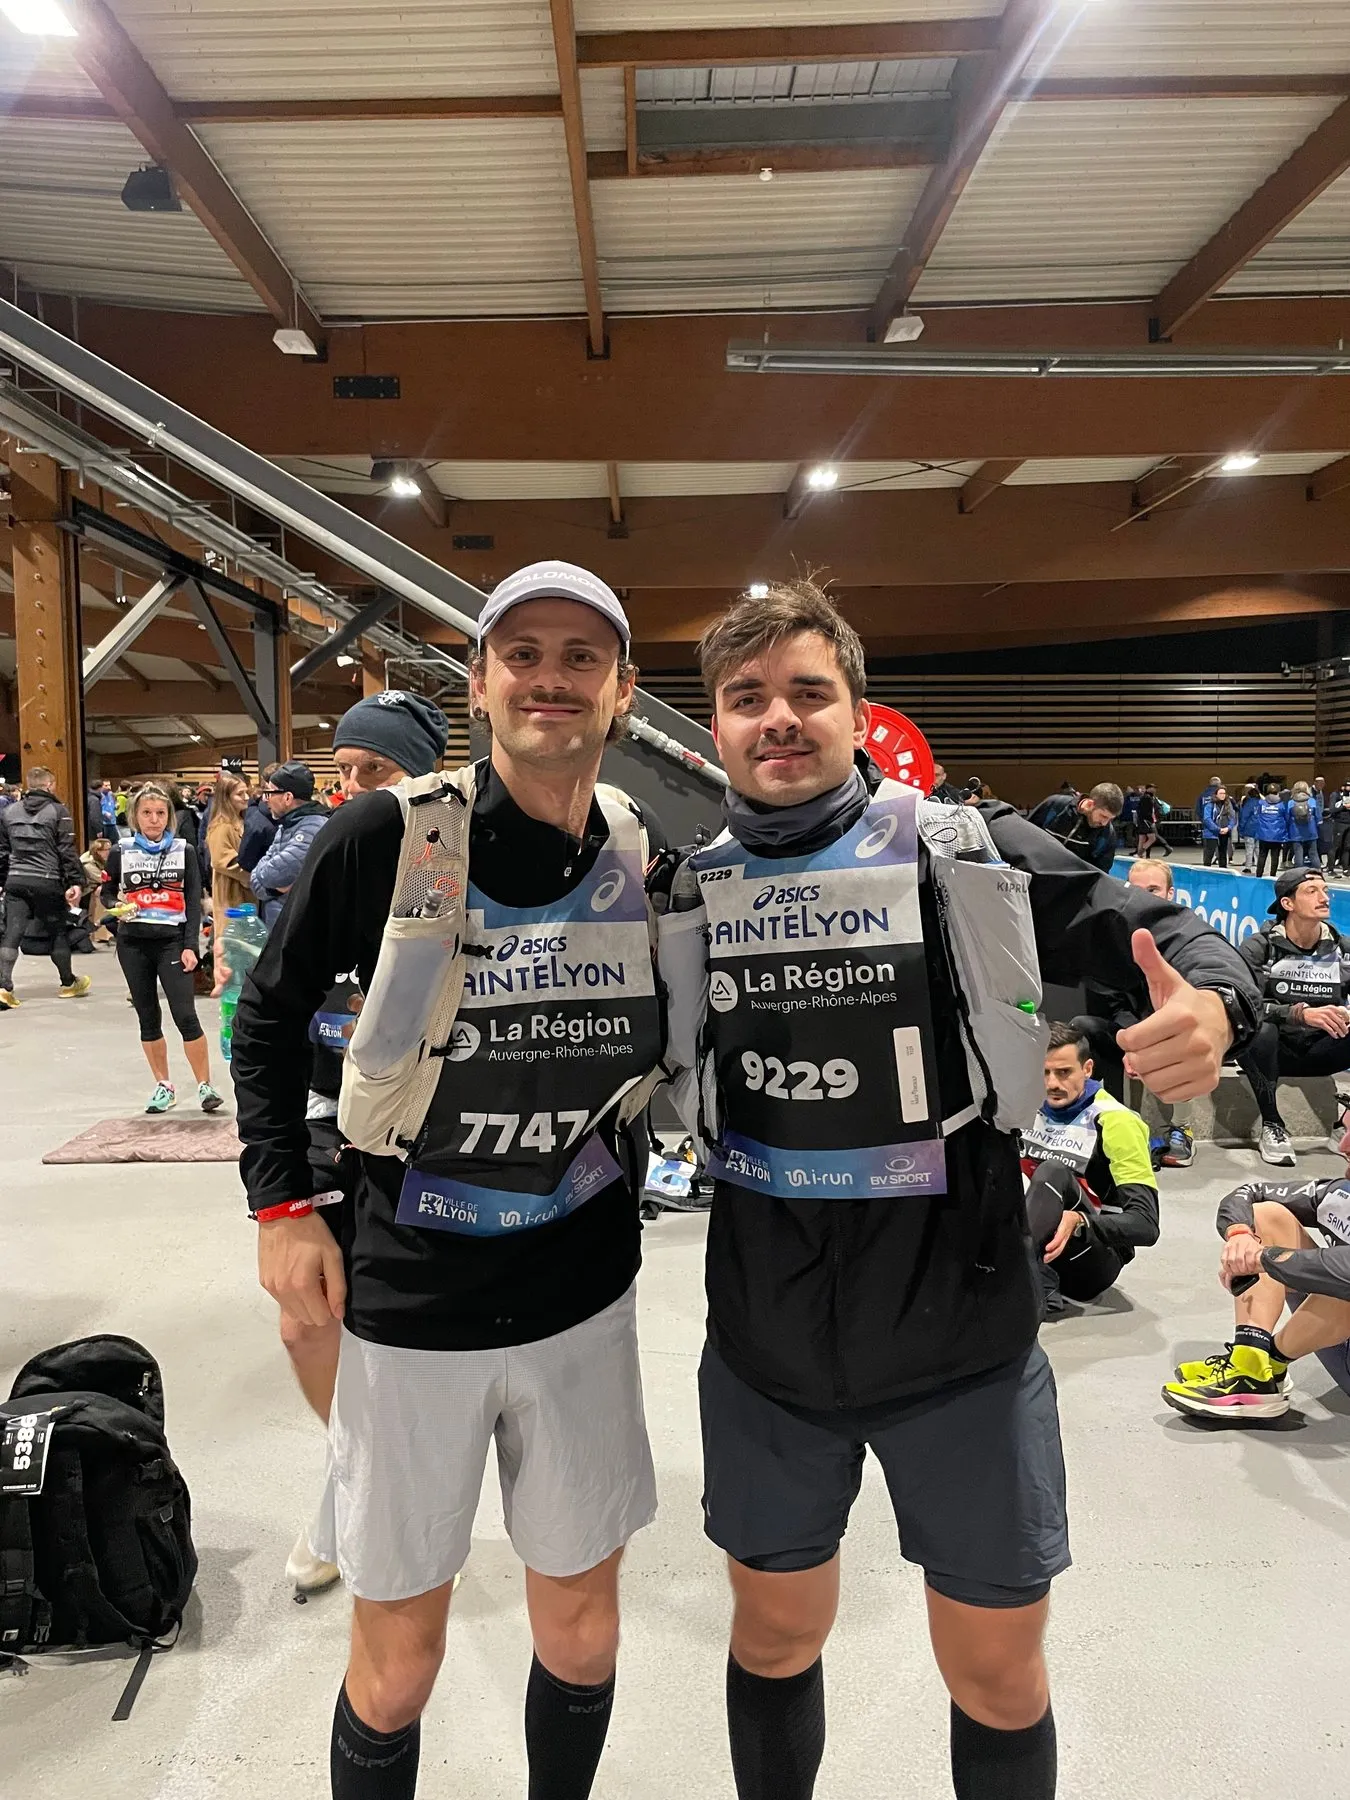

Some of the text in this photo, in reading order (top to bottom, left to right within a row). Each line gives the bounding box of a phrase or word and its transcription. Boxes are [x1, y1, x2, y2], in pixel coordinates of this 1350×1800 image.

[507, 571, 605, 594] SALOMON
[700, 869, 733, 884] 9229
[775, 884, 821, 905] asics
[520, 936, 568, 955] asics
[464, 956, 626, 996] AINTÉLYON
[743, 960, 896, 993] La Région
[1290, 983, 1333, 994] La Région
[751, 990, 898, 1014] Auvergne-Rhône-Alpes
[489, 1011, 631, 1044] La Région
[488, 1043, 633, 1063] Auvergne-Rhône-Alpes
[741, 1050, 859, 1100] 9229
[458, 1109, 590, 1154] 7747
[1028, 1147, 1039, 1158] La
[574, 1165, 604, 1194] SPORT
[745, 1162, 771, 1183] LYON
[811, 1169, 853, 1185] i-run
[870, 1172, 932, 1186] BV SPORT
[442, 1203, 478, 1225] LYON
[444, 1197, 479, 1211] VILLE DE
[524, 1203, 559, 1225] i-run
[12, 1415, 38, 1470] 5386
